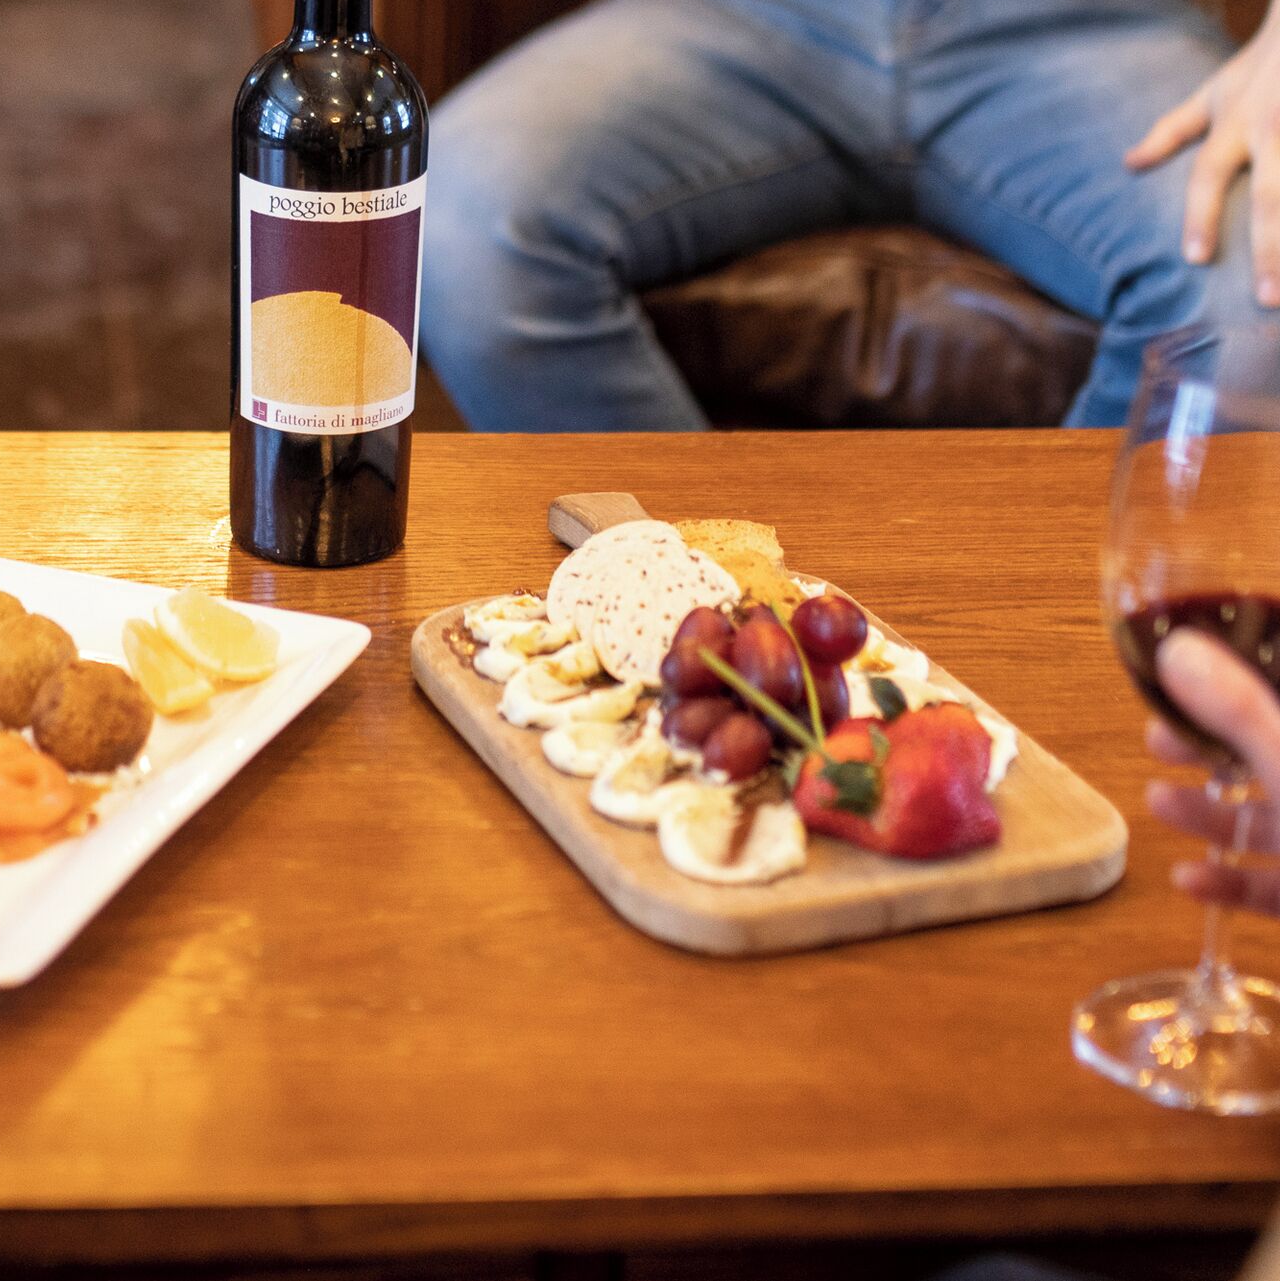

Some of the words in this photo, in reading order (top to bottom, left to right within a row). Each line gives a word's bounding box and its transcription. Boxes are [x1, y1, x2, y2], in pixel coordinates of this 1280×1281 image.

[269, 195, 335, 219] poggio
[342, 191, 407, 215] bestiale
[274, 409, 326, 428] fattoria
[331, 414, 345, 428] di
[351, 405, 404, 427] magliano
